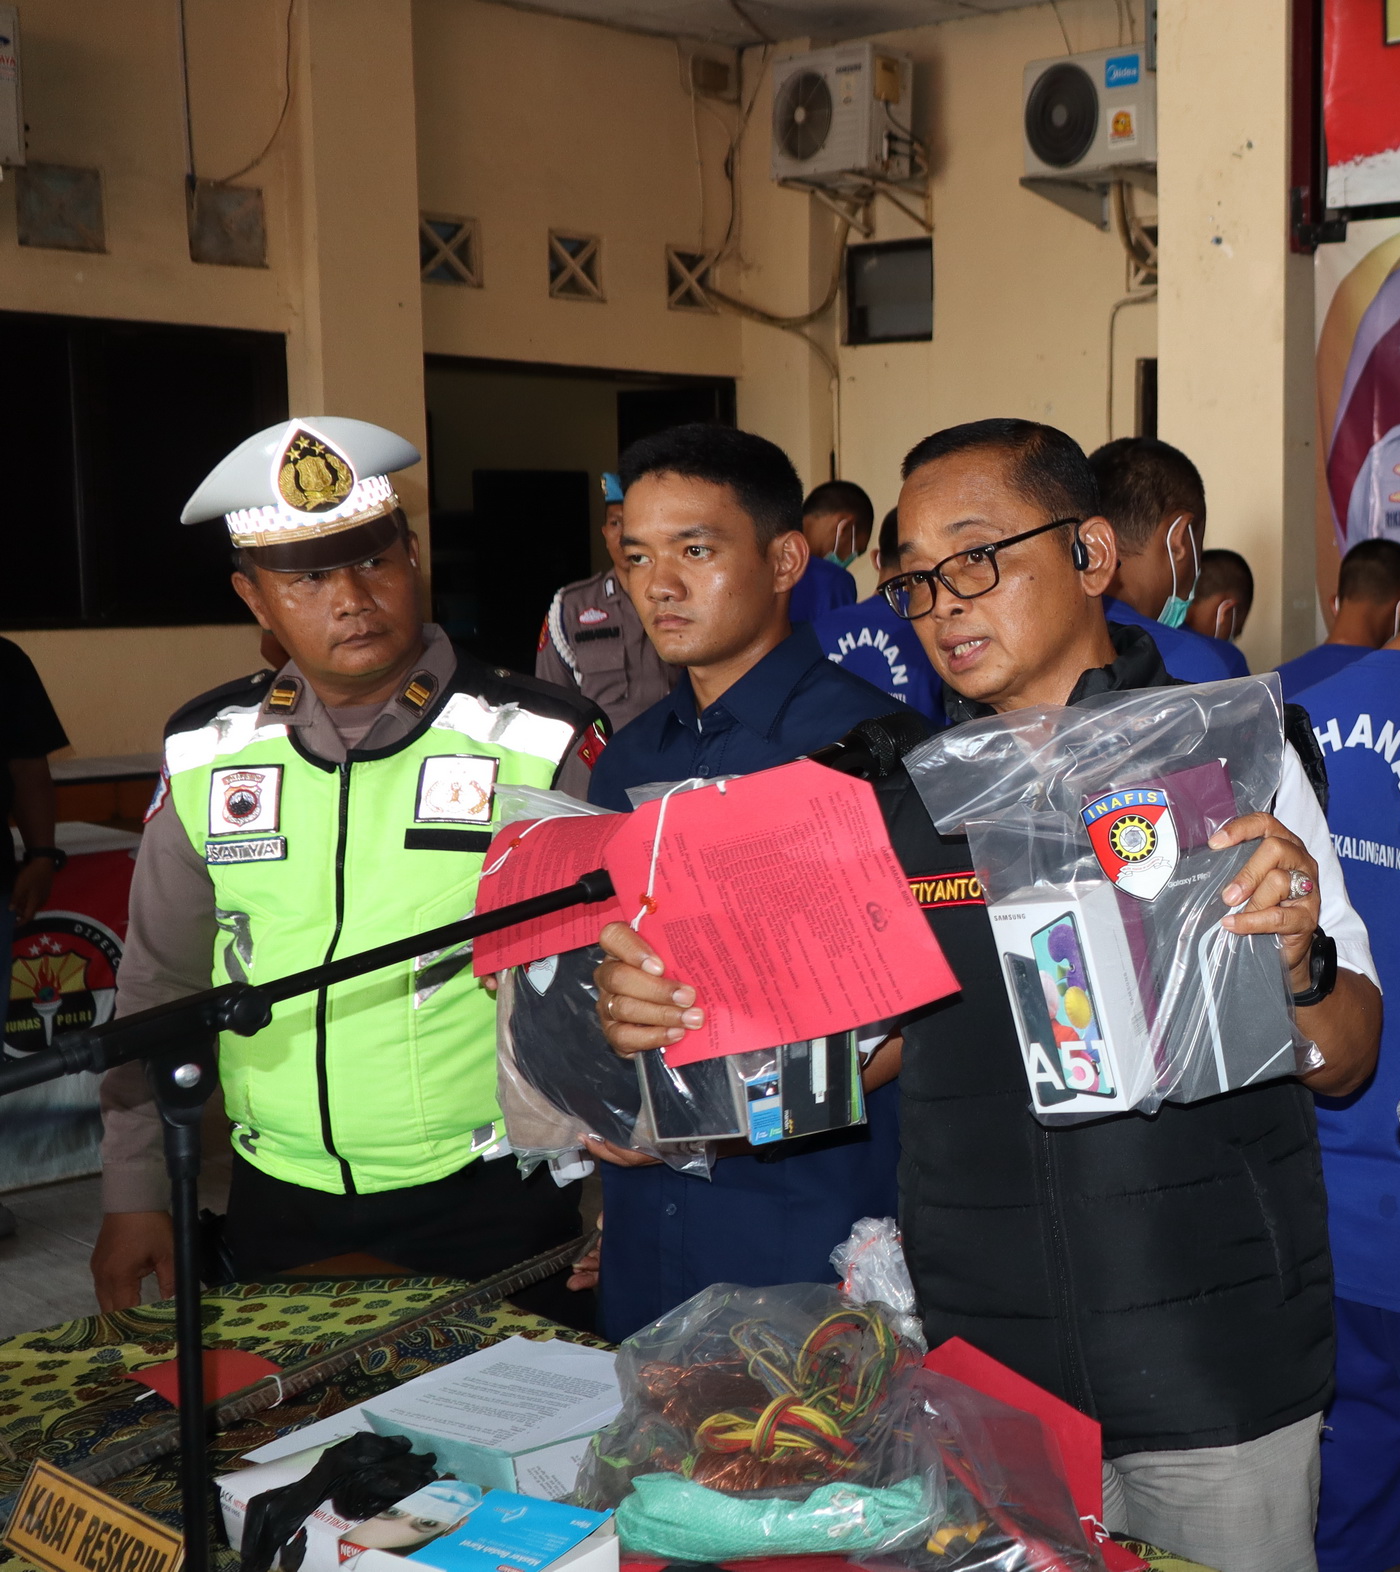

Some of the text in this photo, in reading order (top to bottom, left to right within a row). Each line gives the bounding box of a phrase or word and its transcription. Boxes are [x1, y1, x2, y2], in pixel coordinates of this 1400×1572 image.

[1087, 791, 1159, 820] INAFIS
[210, 841, 274, 860] SATYA
[993, 913, 1027, 922] SAMSUNG
[57, 1010, 92, 1026] POLRI
[18, 1484, 169, 1572] KASAT RESKRIM
